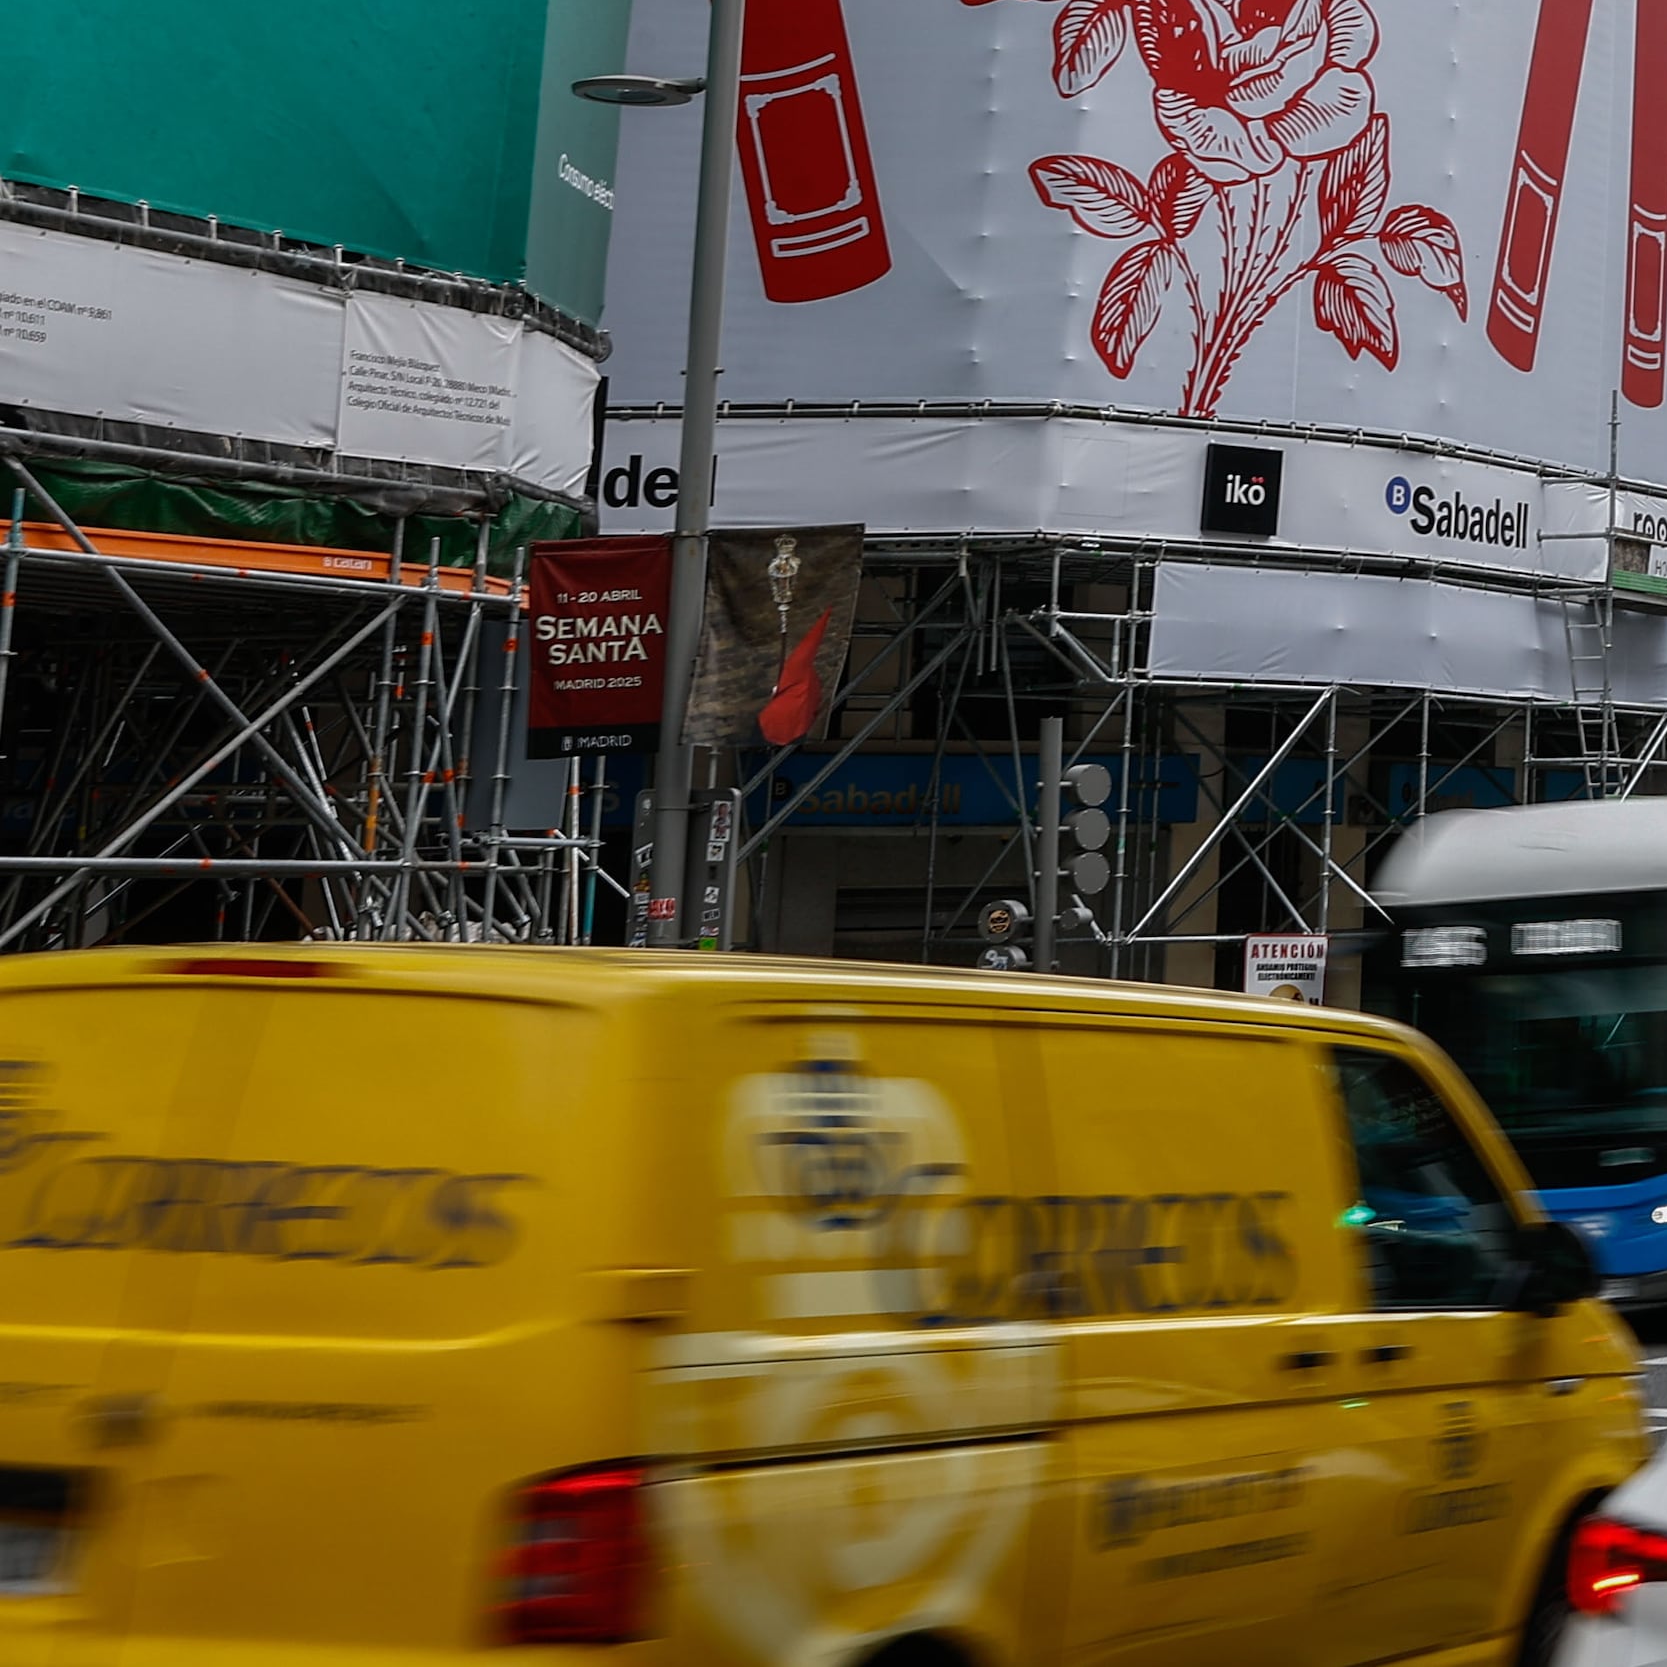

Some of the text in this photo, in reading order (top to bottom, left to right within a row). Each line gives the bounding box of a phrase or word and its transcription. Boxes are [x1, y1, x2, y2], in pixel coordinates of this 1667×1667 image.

[1225, 474, 1266, 507] ikö
[1410, 486, 1528, 548] Sabadell
[557, 593, 568, 604] 11
[578, 591, 597, 604] 20
[600, 589, 643, 602] ABRIL
[536, 614, 664, 641] SEMANA
[548, 636, 648, 666] SANTA
[553, 676, 643, 691] MADRID 2025
[577, 735, 632, 749] MADRID
[797, 782, 961, 816] Sabadll
[1251, 942, 1324, 958] ATENCIÓN
